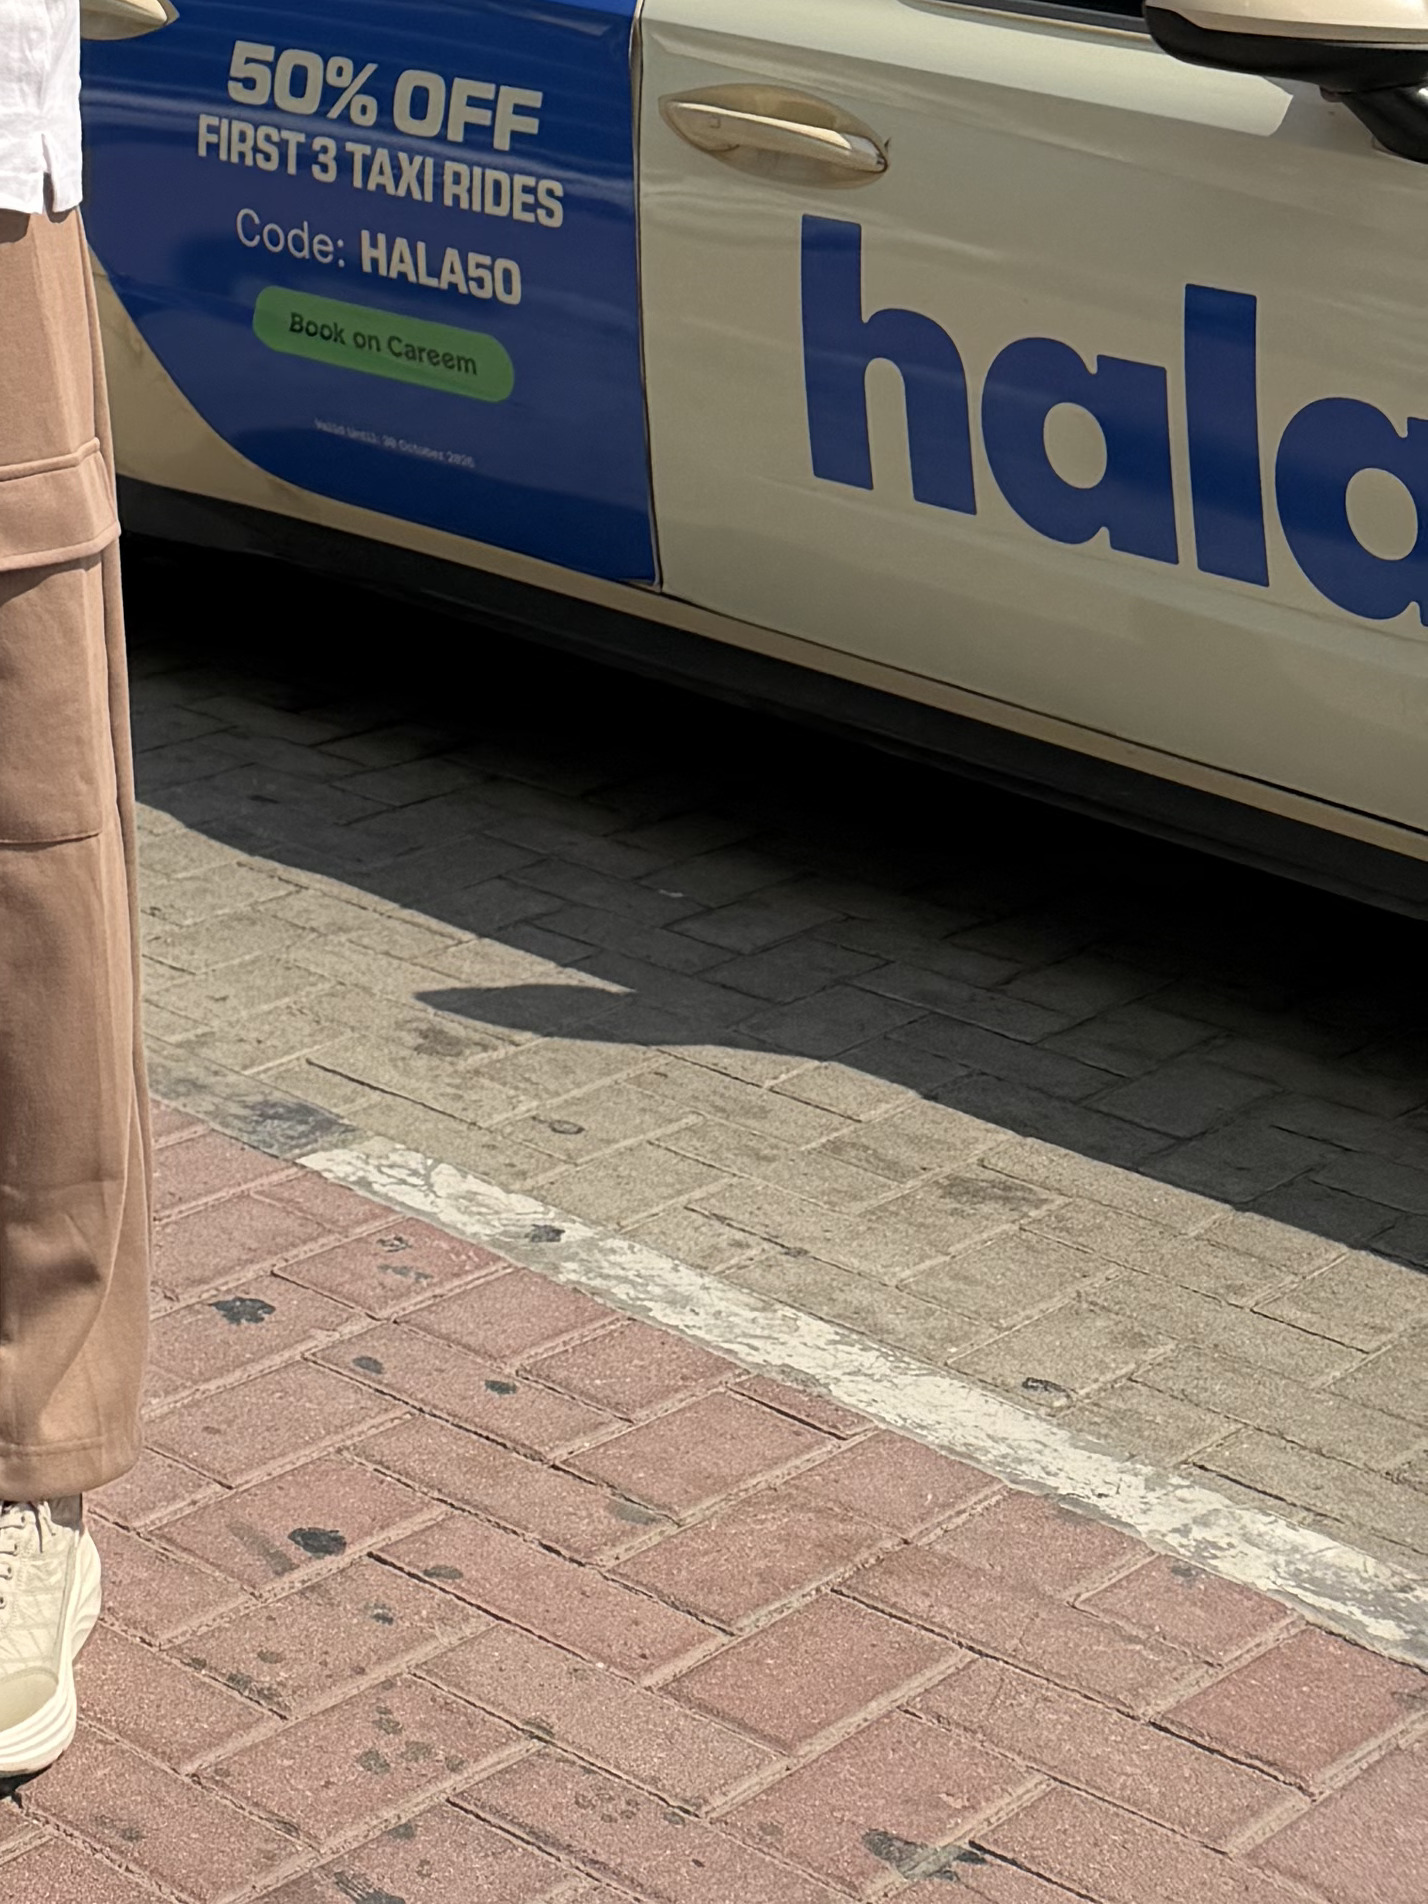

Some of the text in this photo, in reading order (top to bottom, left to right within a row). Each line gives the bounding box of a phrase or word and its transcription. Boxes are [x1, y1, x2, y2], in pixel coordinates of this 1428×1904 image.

[227, 40, 543, 151] 50% OFF
[198, 113, 564, 228] FIRST 3 TAXI RIDES
[236, 208, 522, 305] Code: HALA50
[289, 312, 478, 375] Book on Careem
